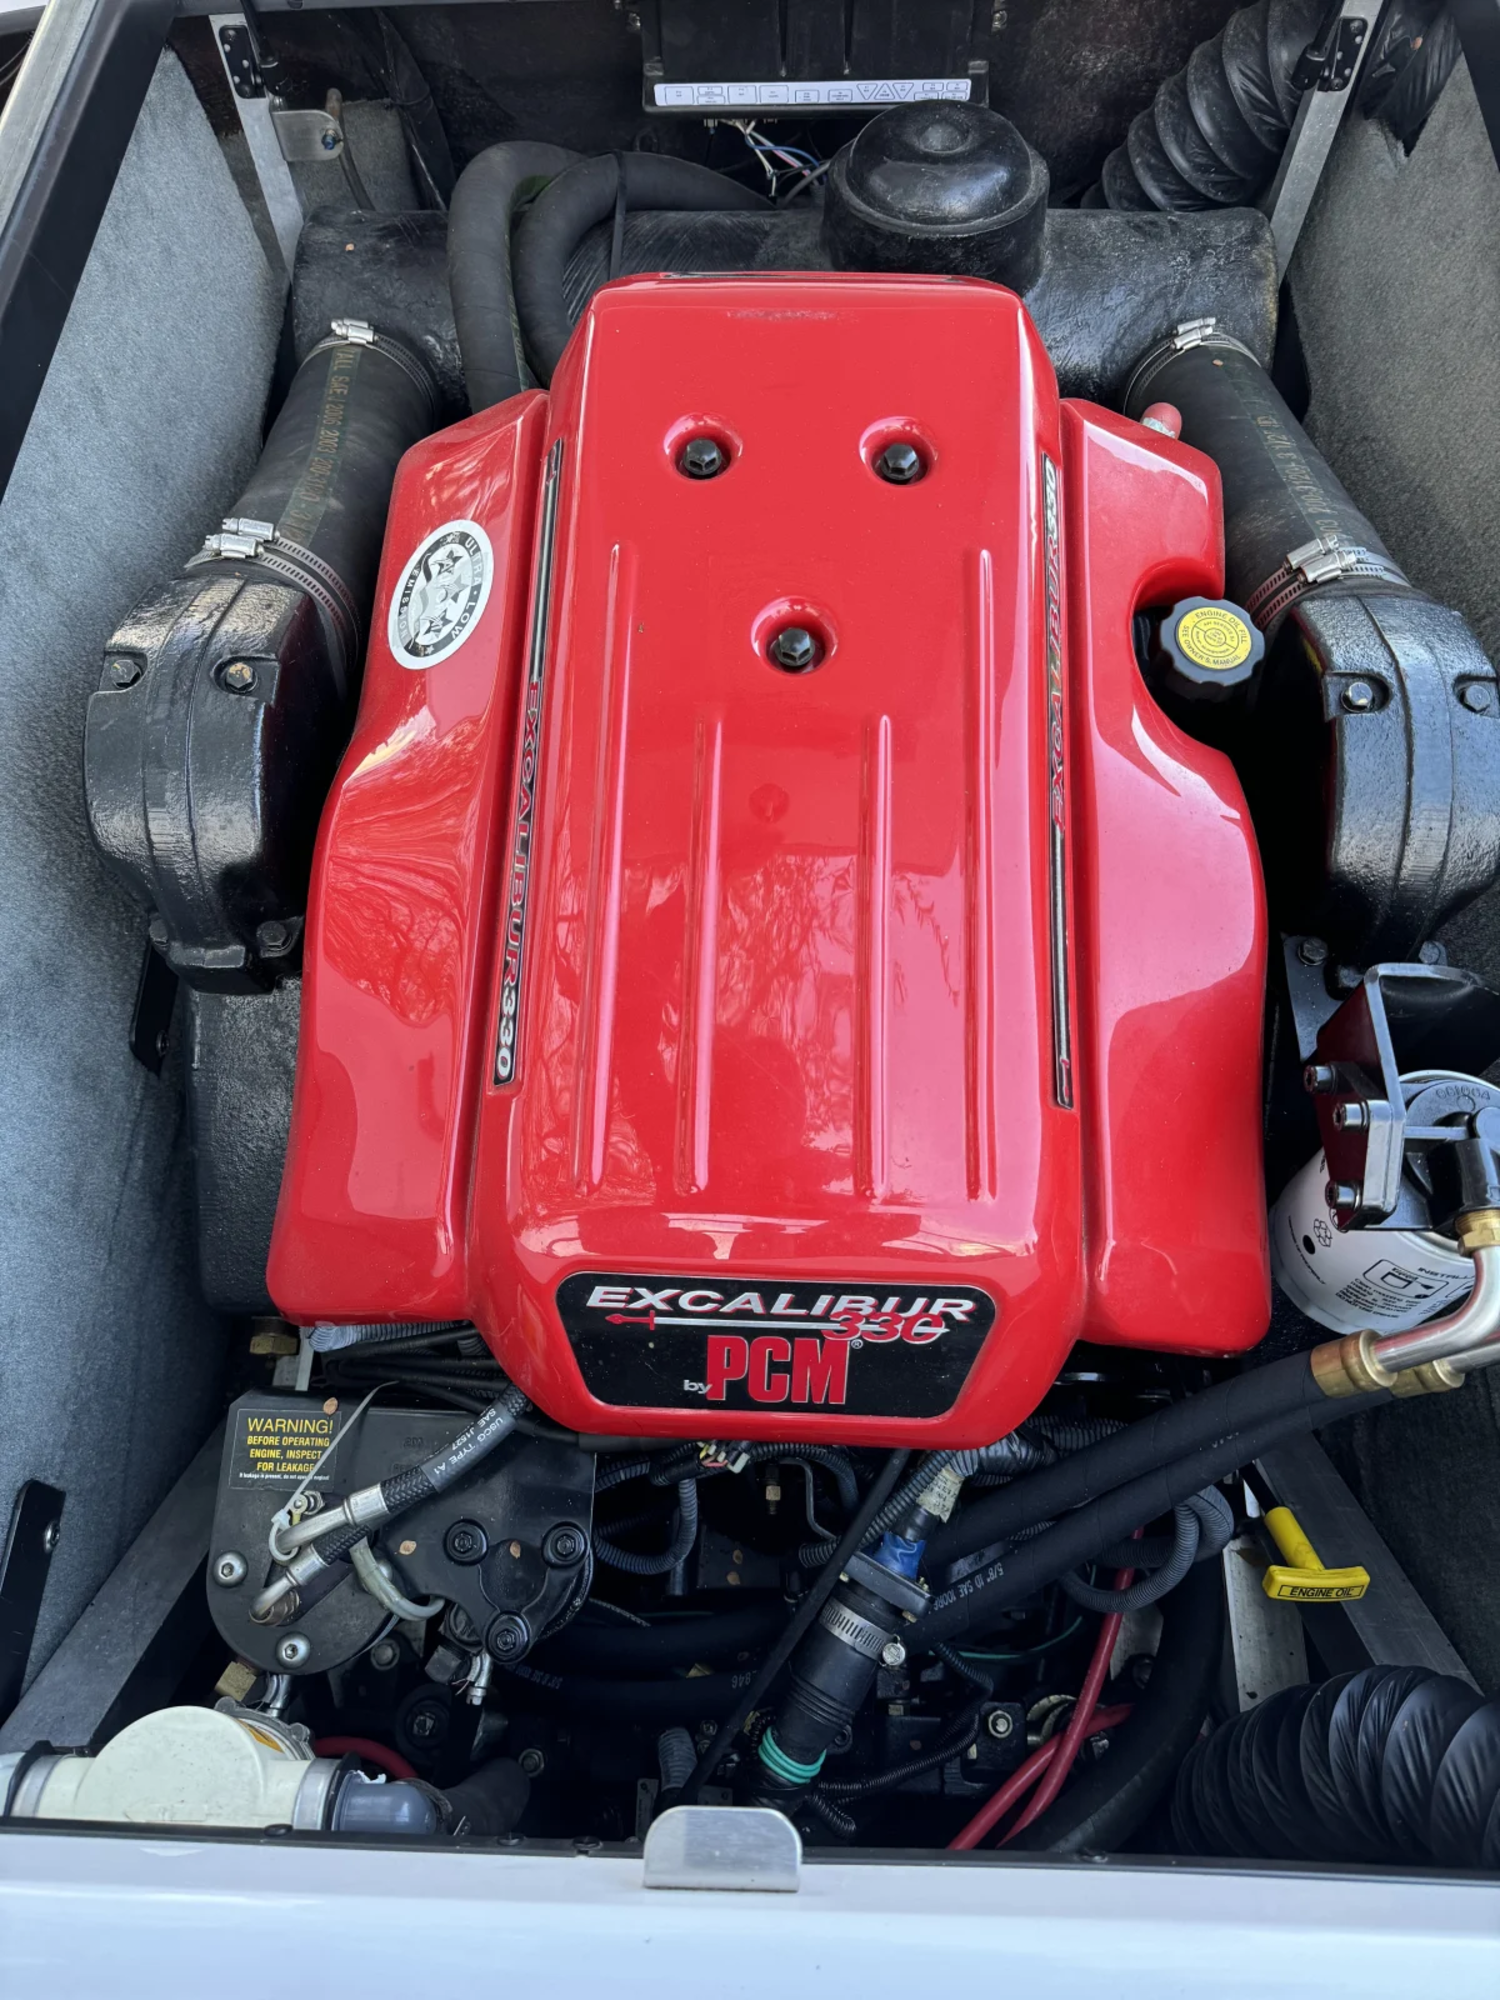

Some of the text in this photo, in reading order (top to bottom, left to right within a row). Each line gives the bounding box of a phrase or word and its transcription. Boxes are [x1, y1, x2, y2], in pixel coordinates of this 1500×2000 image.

[450, 536, 483, 640] ULTRA LOW
[398, 567, 420, 642] EMISSION
[1195, 609, 1228, 620] ENGINE
[1228, 616, 1241, 628] OIL
[1238, 628, 1248, 645] FILL
[1181, 624, 1190, 638] SEE
[1212, 653, 1241, 666] MANUAL
[504, 681, 540, 986] EXCALIBUR
[497, 986, 516, 1078] 330
[586, 1286, 976, 1321] EXCALIBUR
[820, 1312, 946, 1344] 330
[683, 1378, 713, 1395] by
[248, 1417, 333, 1434] WARNING!
[452, 1408, 496, 1451] SAE J1527
[477, 1417, 503, 1442] USCG
[247, 1435, 330, 1447] BEFORE OPERATING
[249, 1448, 322, 1460] ENGINE, INSPECT
[256, 1461, 275, 1471] FOR
[449, 1443, 475, 1465] TYPE
[433, 1462, 446, 1475] A1
[957, 1580, 974, 1598] SAE
[1289, 1586, 1354, 1597] ENGINE OIL
